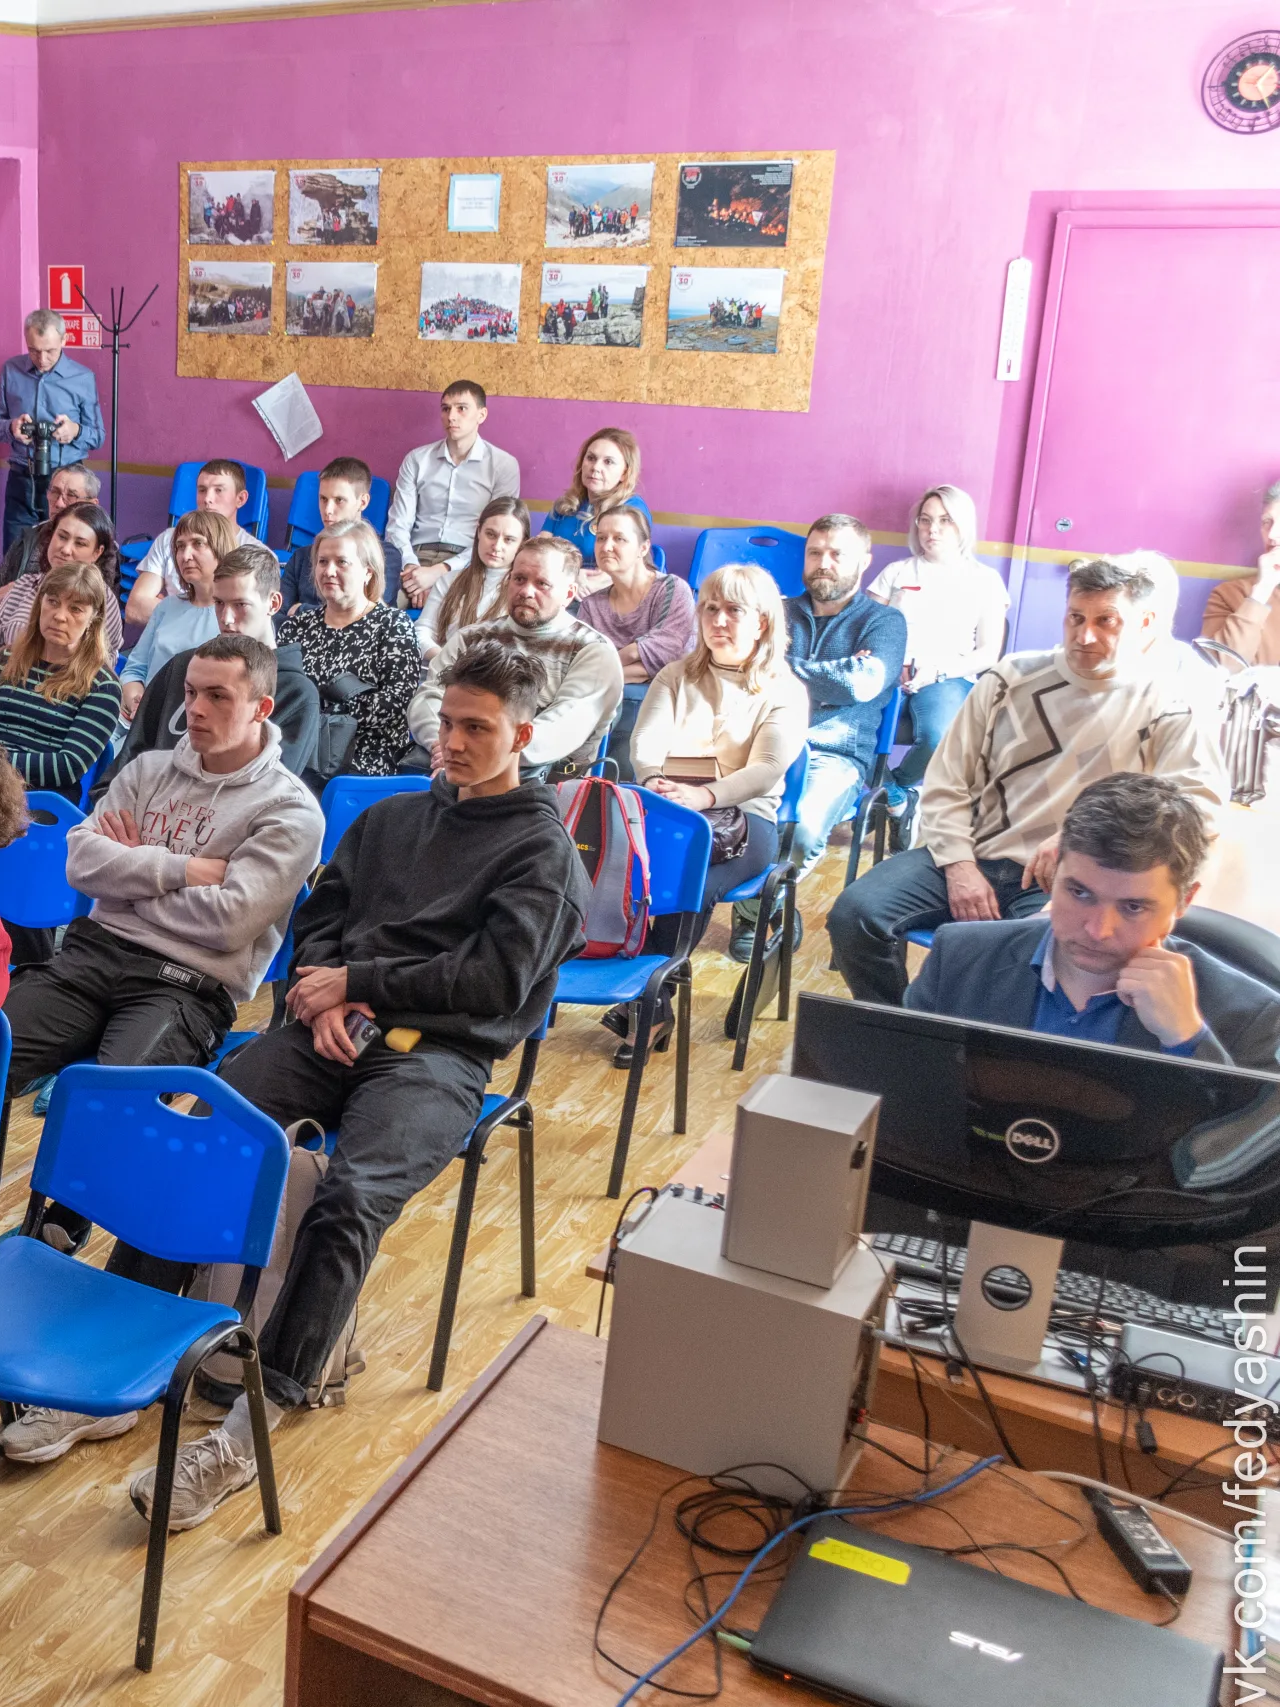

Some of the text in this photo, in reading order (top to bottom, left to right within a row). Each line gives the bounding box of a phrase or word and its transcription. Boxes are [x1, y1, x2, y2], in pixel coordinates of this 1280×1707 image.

[162, 798, 216, 824] NEVER
[195, 825, 216, 846] U
[1011, 1131, 1053, 1150] DELL
